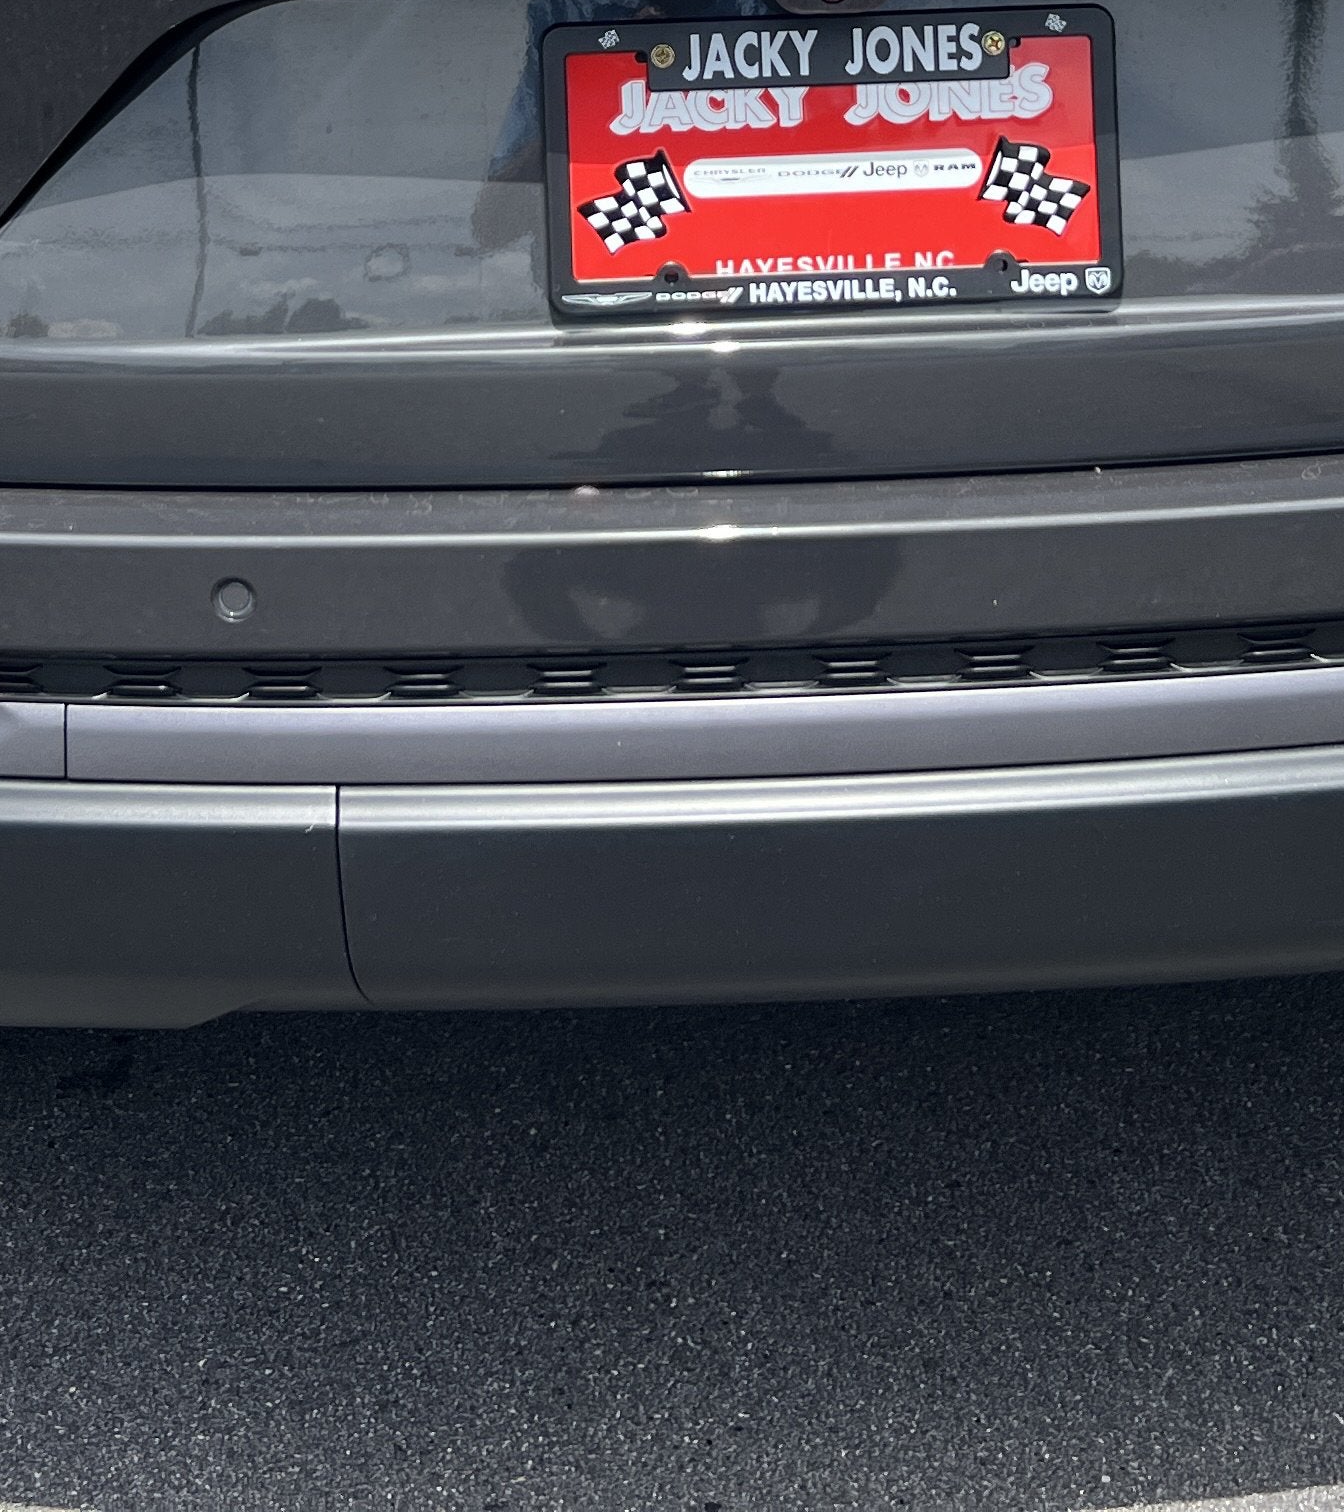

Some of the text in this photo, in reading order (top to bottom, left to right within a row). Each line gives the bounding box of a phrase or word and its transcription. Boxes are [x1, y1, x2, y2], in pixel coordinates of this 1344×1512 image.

[682, 23, 983, 82] JACKY JONES
[609, 62, 1053, 136] JACKY JONES
[863, 161, 908, 177] Jeep
[933, 163, 976, 171] RAM
[749, 277, 902, 304] HAYESVILLE,
[908, 274, 957, 299] N.C.
[1011, 269, 1078, 297] Jeep
